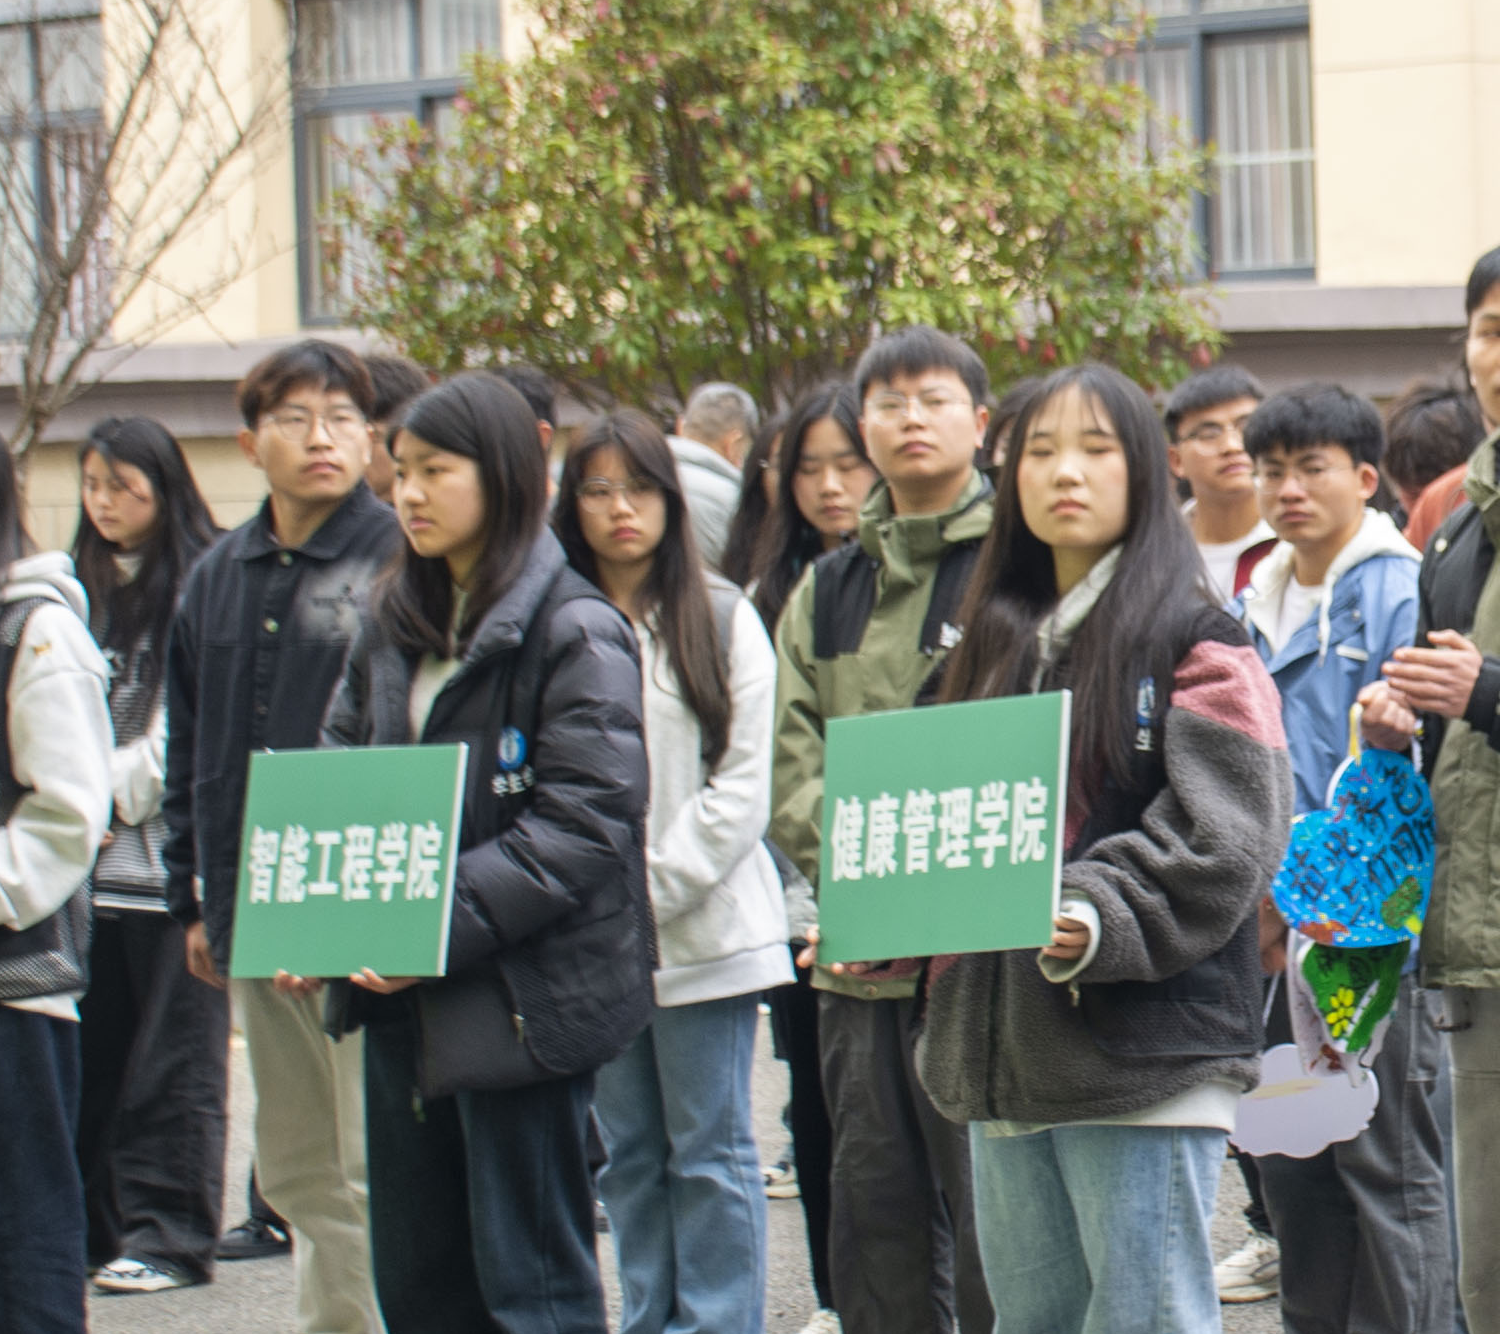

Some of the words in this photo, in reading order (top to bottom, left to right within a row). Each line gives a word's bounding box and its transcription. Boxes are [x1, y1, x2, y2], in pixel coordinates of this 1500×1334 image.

[247, 819, 443, 905] 智能工程学院
[830, 775, 1049, 883] 健康管理学院
